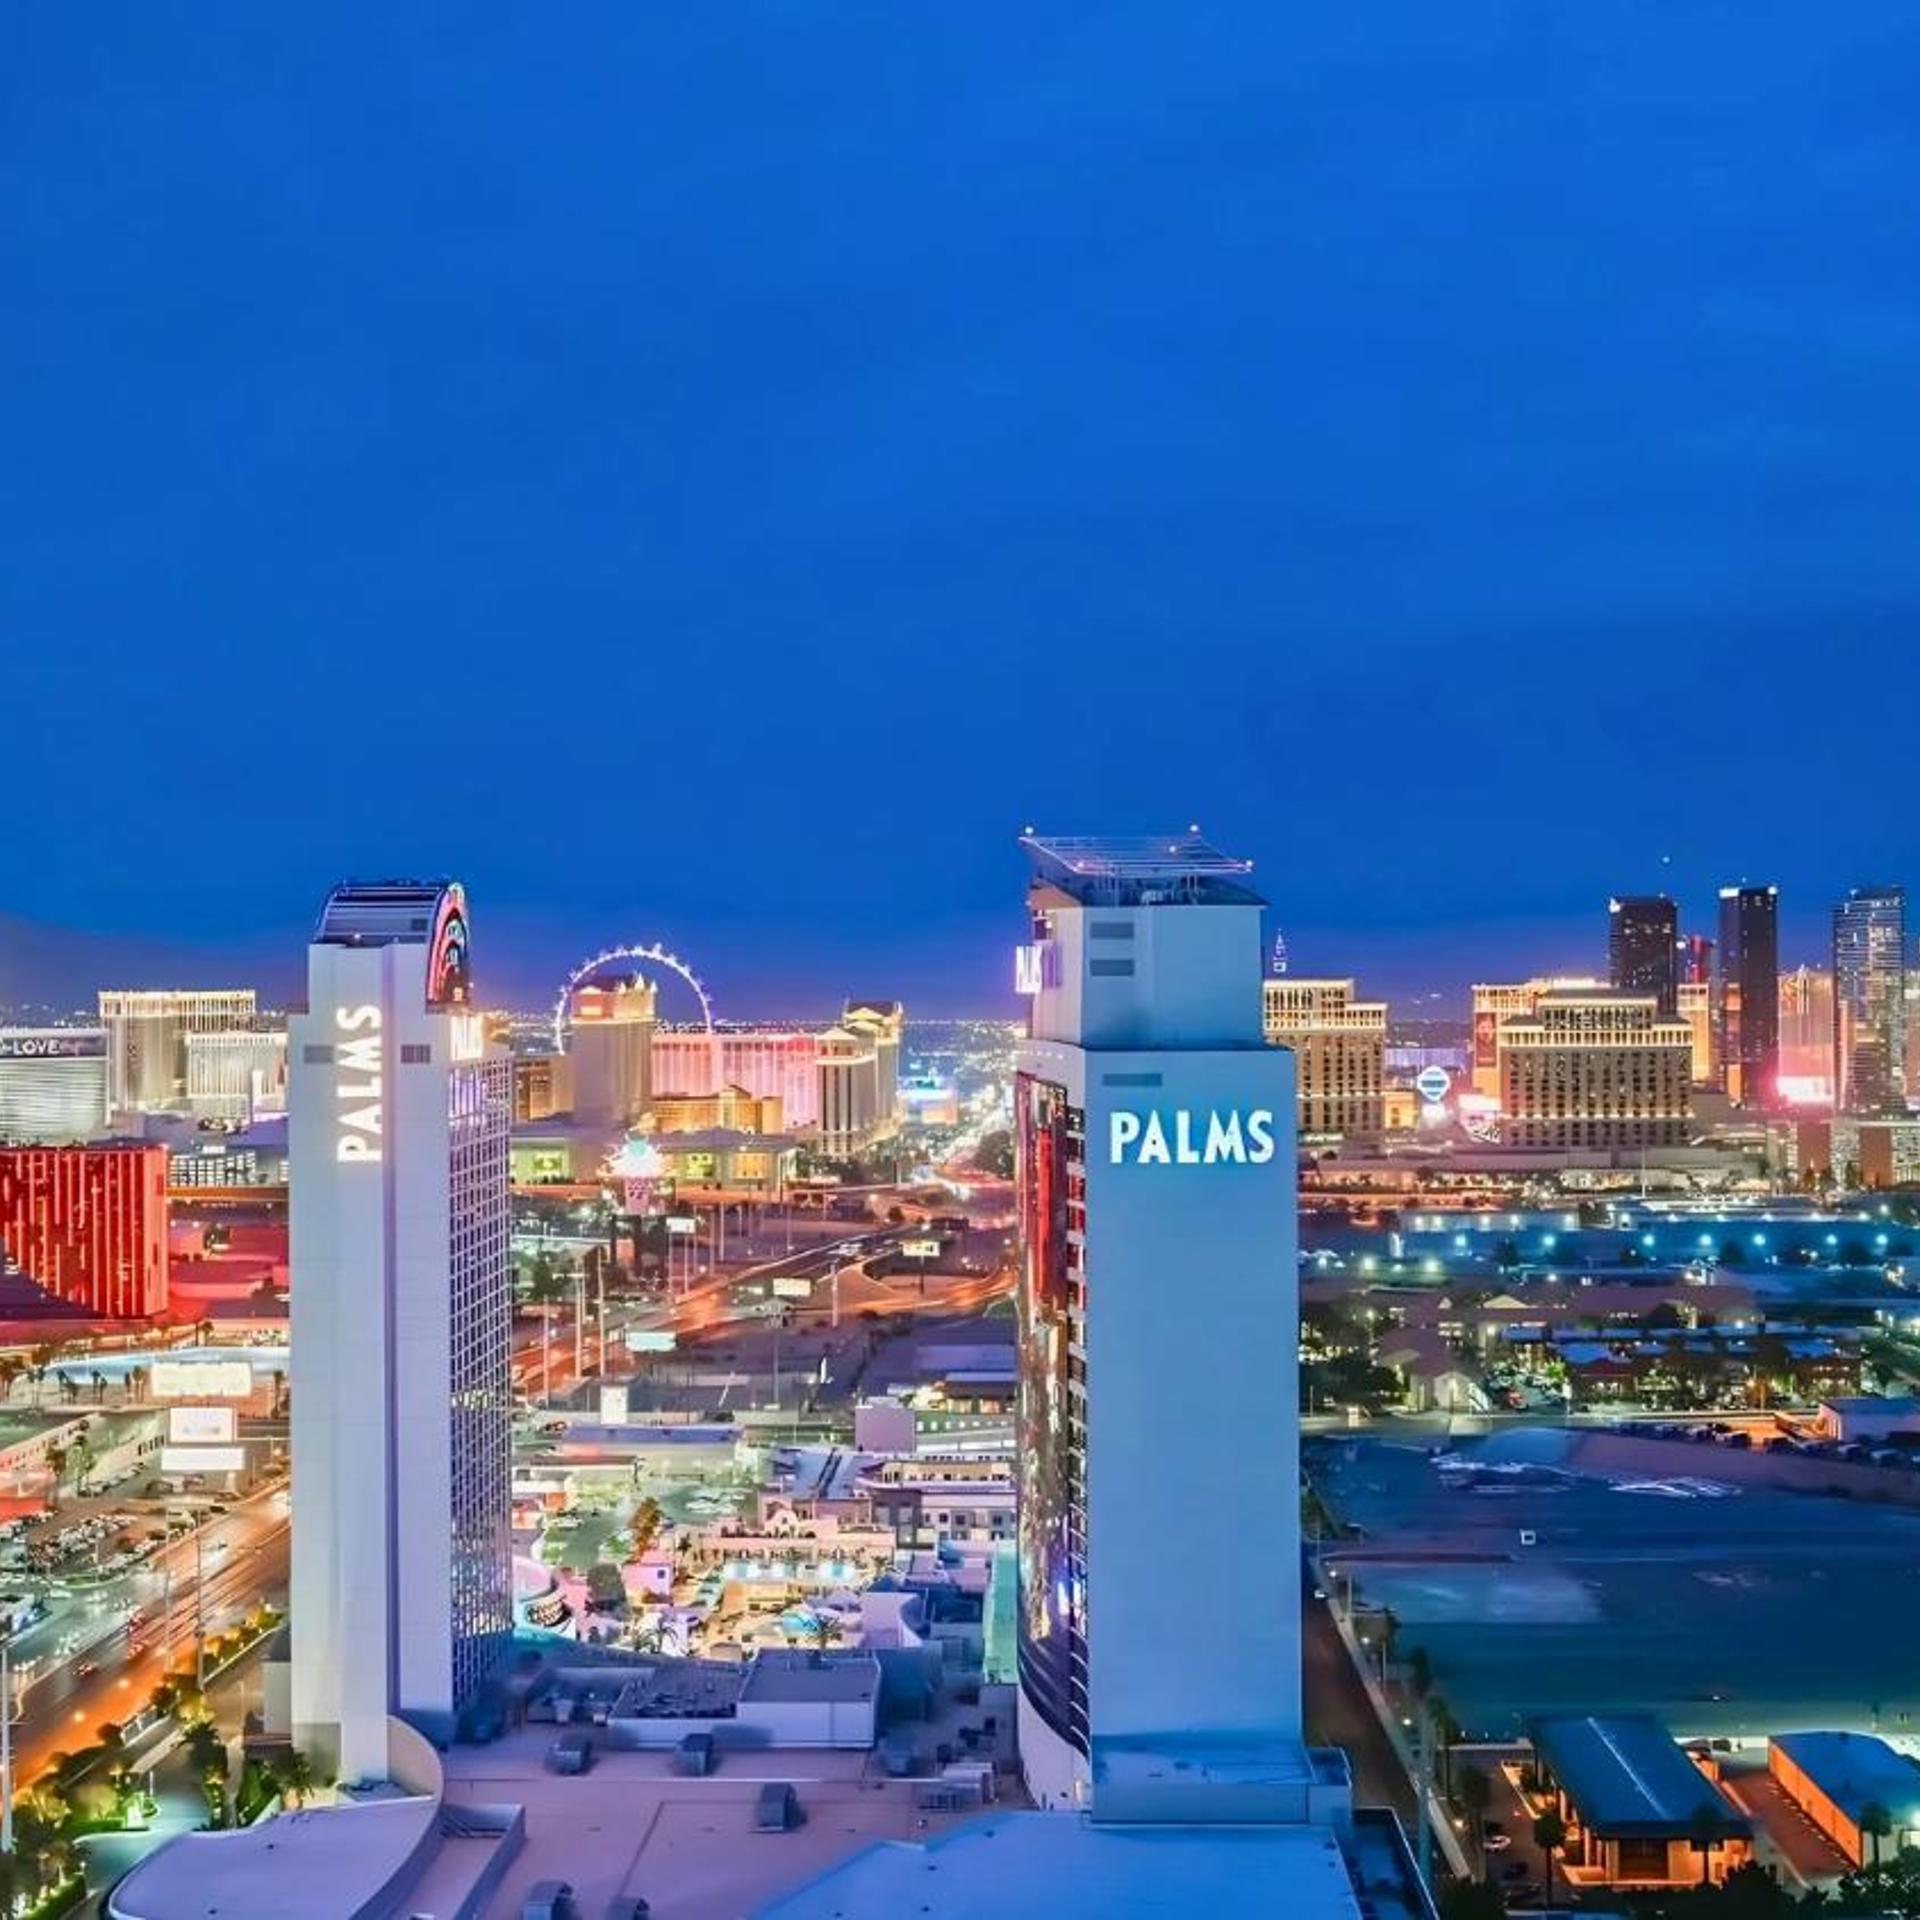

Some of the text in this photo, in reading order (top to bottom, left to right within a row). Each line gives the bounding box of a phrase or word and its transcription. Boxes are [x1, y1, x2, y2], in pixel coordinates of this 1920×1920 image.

[13, 1039, 60, 1055] LOVE
[336, 1004, 383, 1162] PALMS
[1110, 1109, 1275, 1164] PALMS
